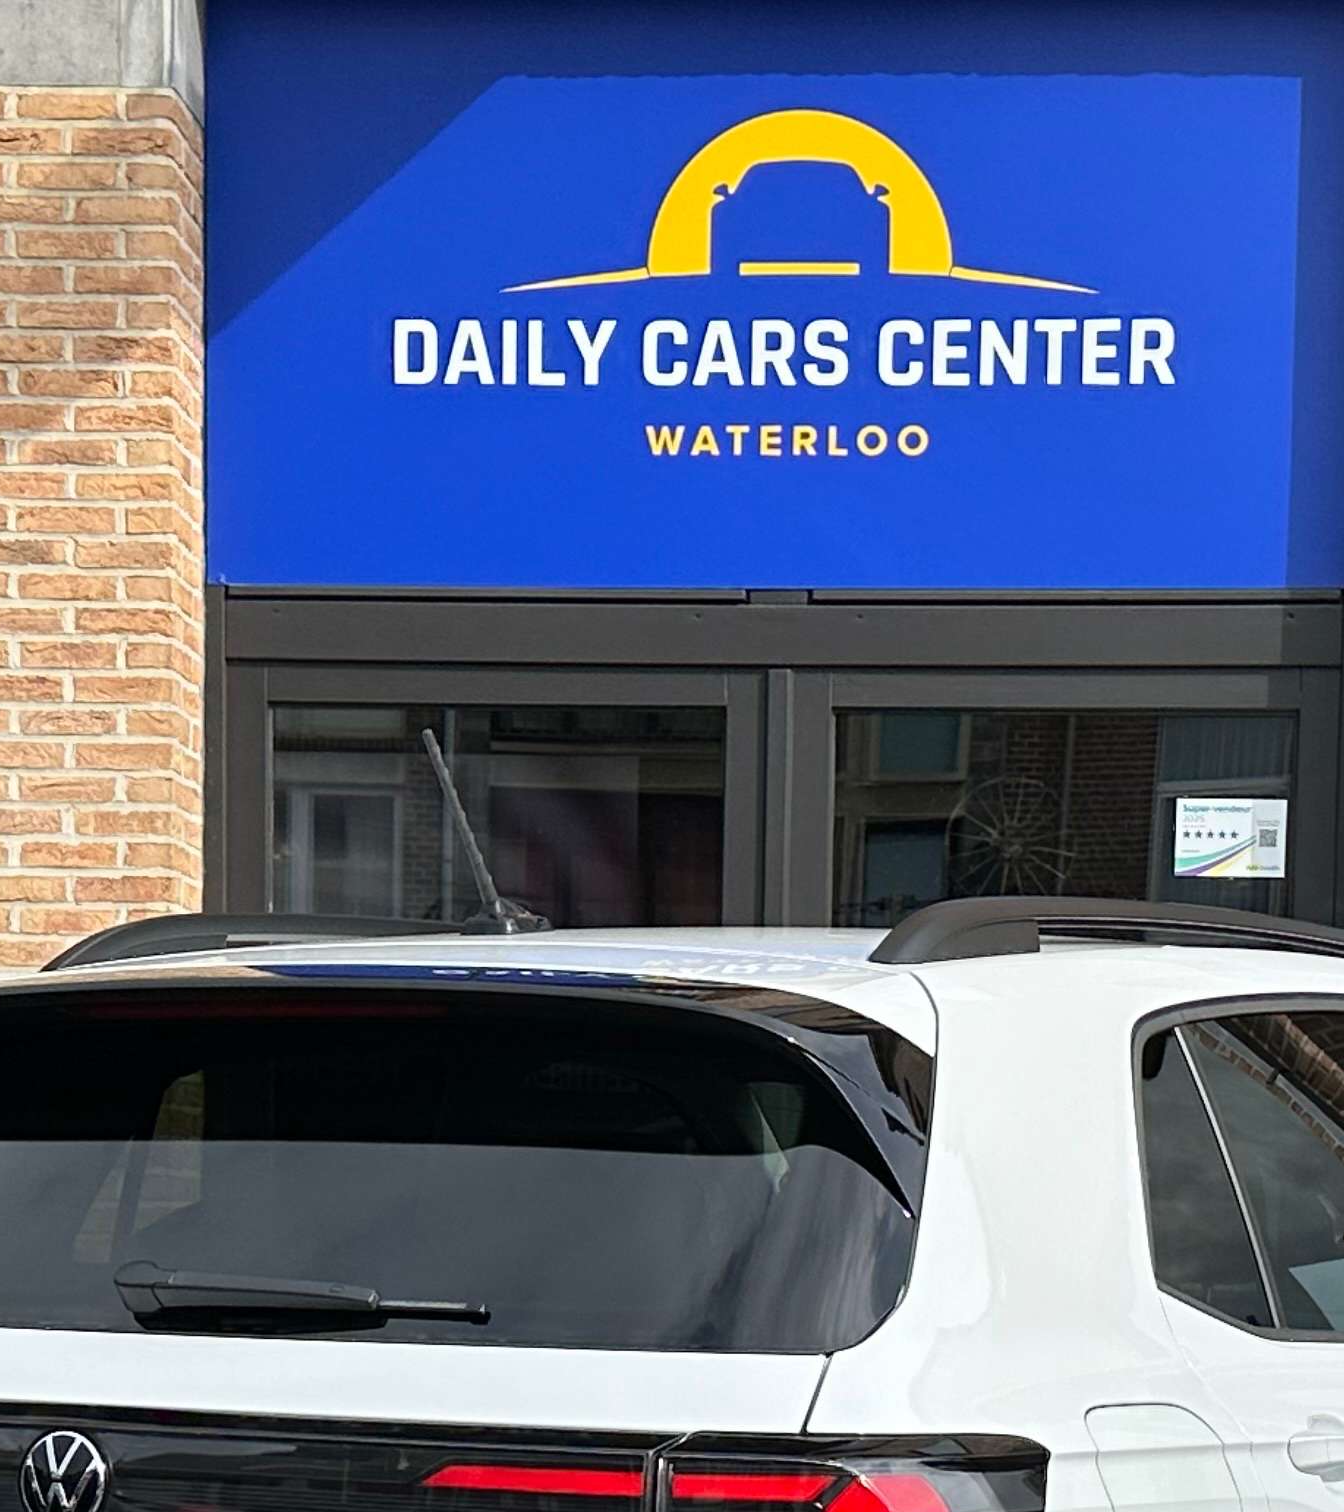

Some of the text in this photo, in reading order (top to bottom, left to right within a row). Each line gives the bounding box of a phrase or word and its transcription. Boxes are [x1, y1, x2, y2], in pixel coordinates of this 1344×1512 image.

[391, 318, 1177, 386] DAILY CARS CENTER
[646, 425, 931, 457] WATERLOO
